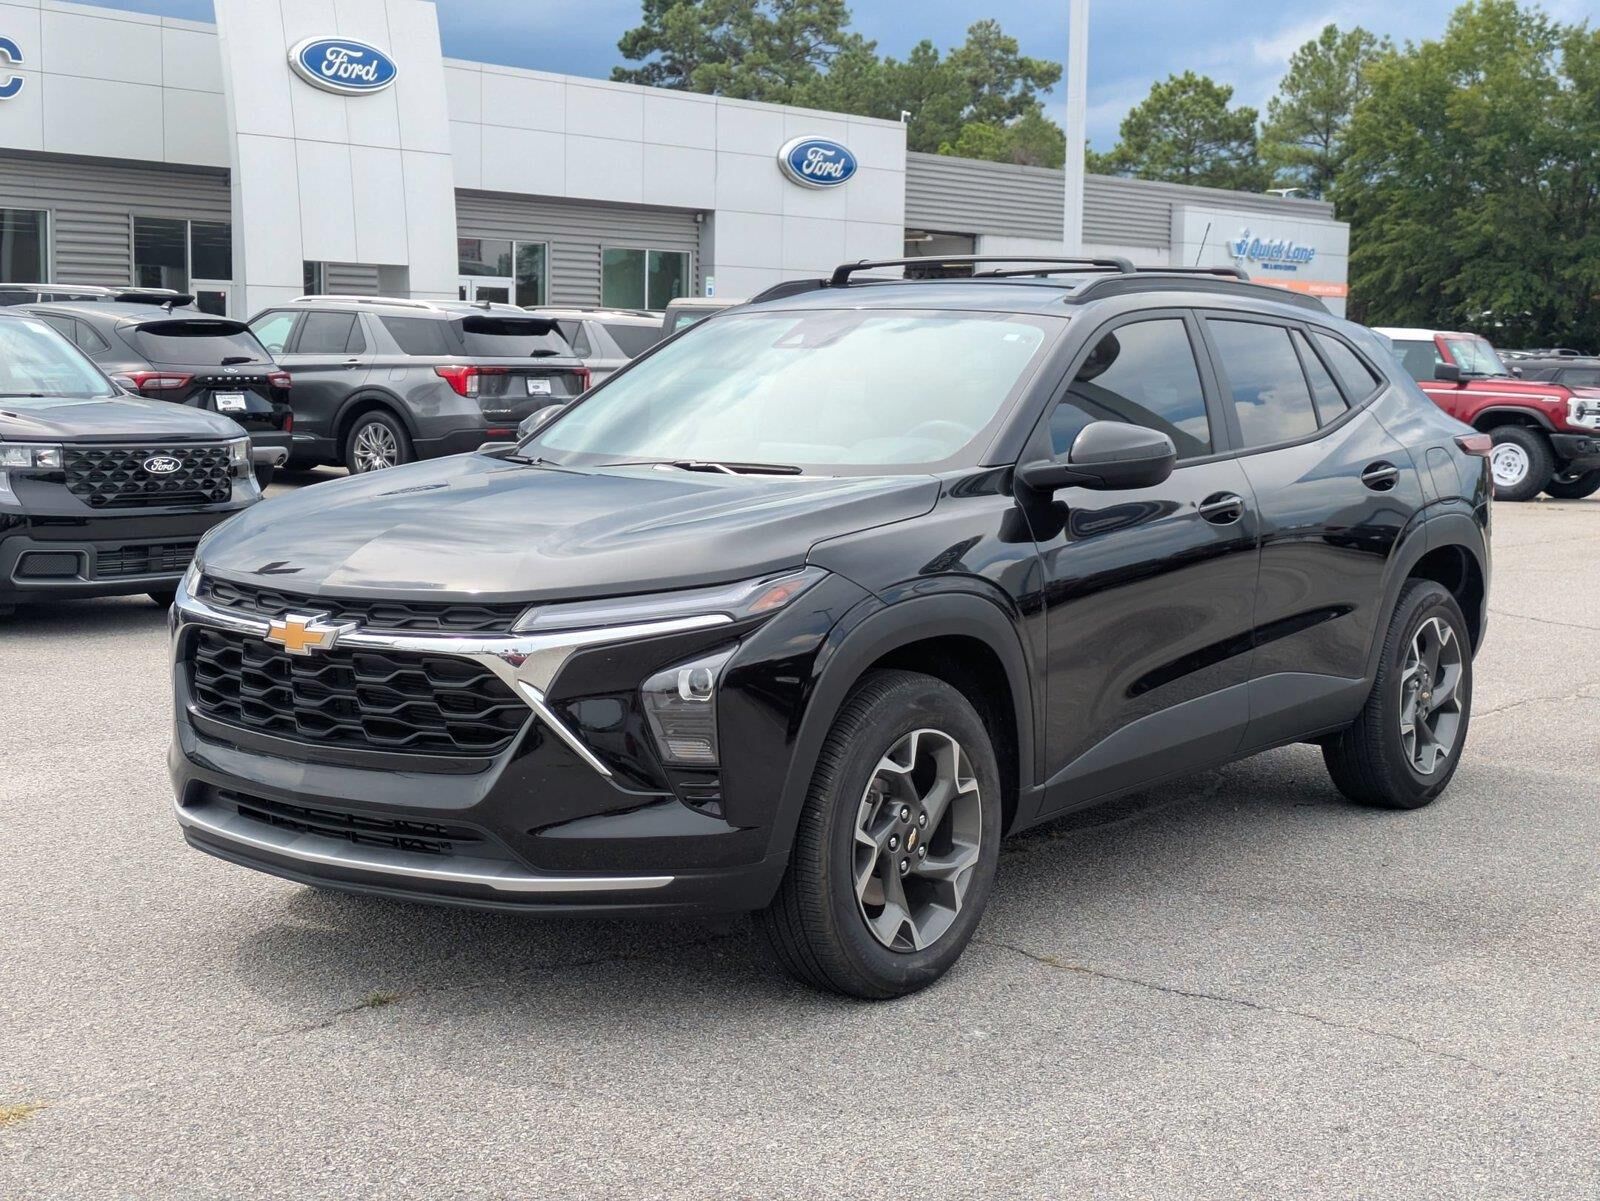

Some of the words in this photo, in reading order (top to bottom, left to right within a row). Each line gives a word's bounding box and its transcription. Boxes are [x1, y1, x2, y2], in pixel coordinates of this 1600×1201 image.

[321, 46, 378, 81] Ford
[802, 147, 845, 177] Ford
[1250, 238, 1284, 259] Quick
[1286, 241, 1315, 260] Lane
[151, 459, 175, 471] Ford
